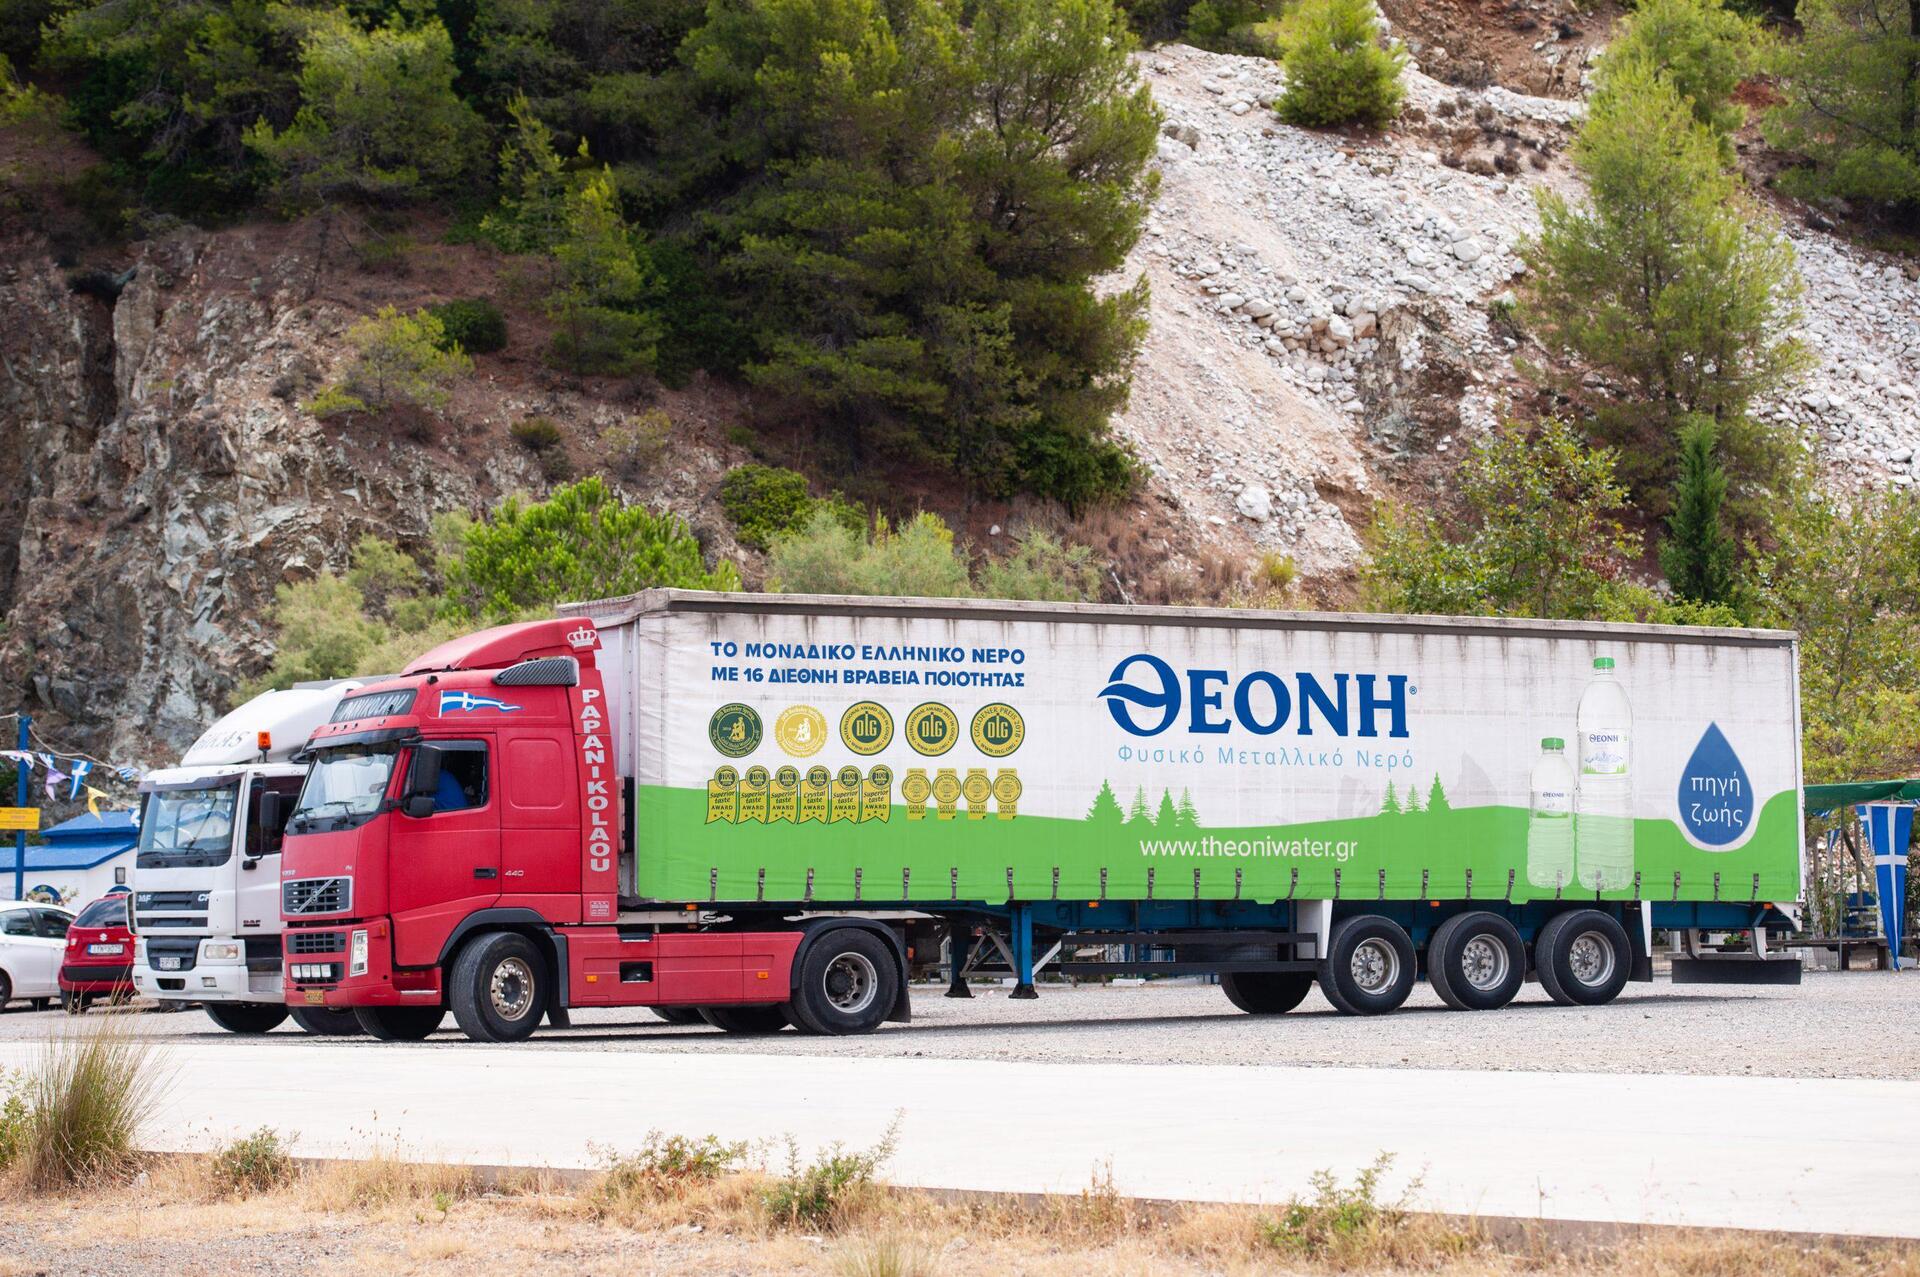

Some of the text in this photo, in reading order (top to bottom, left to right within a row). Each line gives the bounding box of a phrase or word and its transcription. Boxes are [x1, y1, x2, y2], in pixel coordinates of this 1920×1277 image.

[710, 642, 1025, 665] ΤΟ ΜΟΝΑΔΙΚΟ ΕΛΛΗΝΙΚΟ ΝΕΡΟ
[711, 667, 1025, 687] ΜΕ 16 ΔΙΕΘΝΗ ΒΡΑΒΕΙΑ ΠΟΙΟΤΗΤΑΣ
[1096, 654, 1410, 738] ΘΕΟΝΗ
[856, 714, 877, 736] DLG
[922, 714, 942, 737] DLG
[988, 716, 1008, 738] DLG
[1590, 734, 1618, 742] ΘΕΟΝΗ
[1118, 744, 1414, 772] Φυσικό Μεταλλικό Νερό
[580, 689, 611, 872] PAPANIKOLAOU
[1690, 770, 1740, 797] πηγή
[1690, 802, 1744, 828] ζωής
[1140, 836, 1358, 862] www.theoniwater.gr
